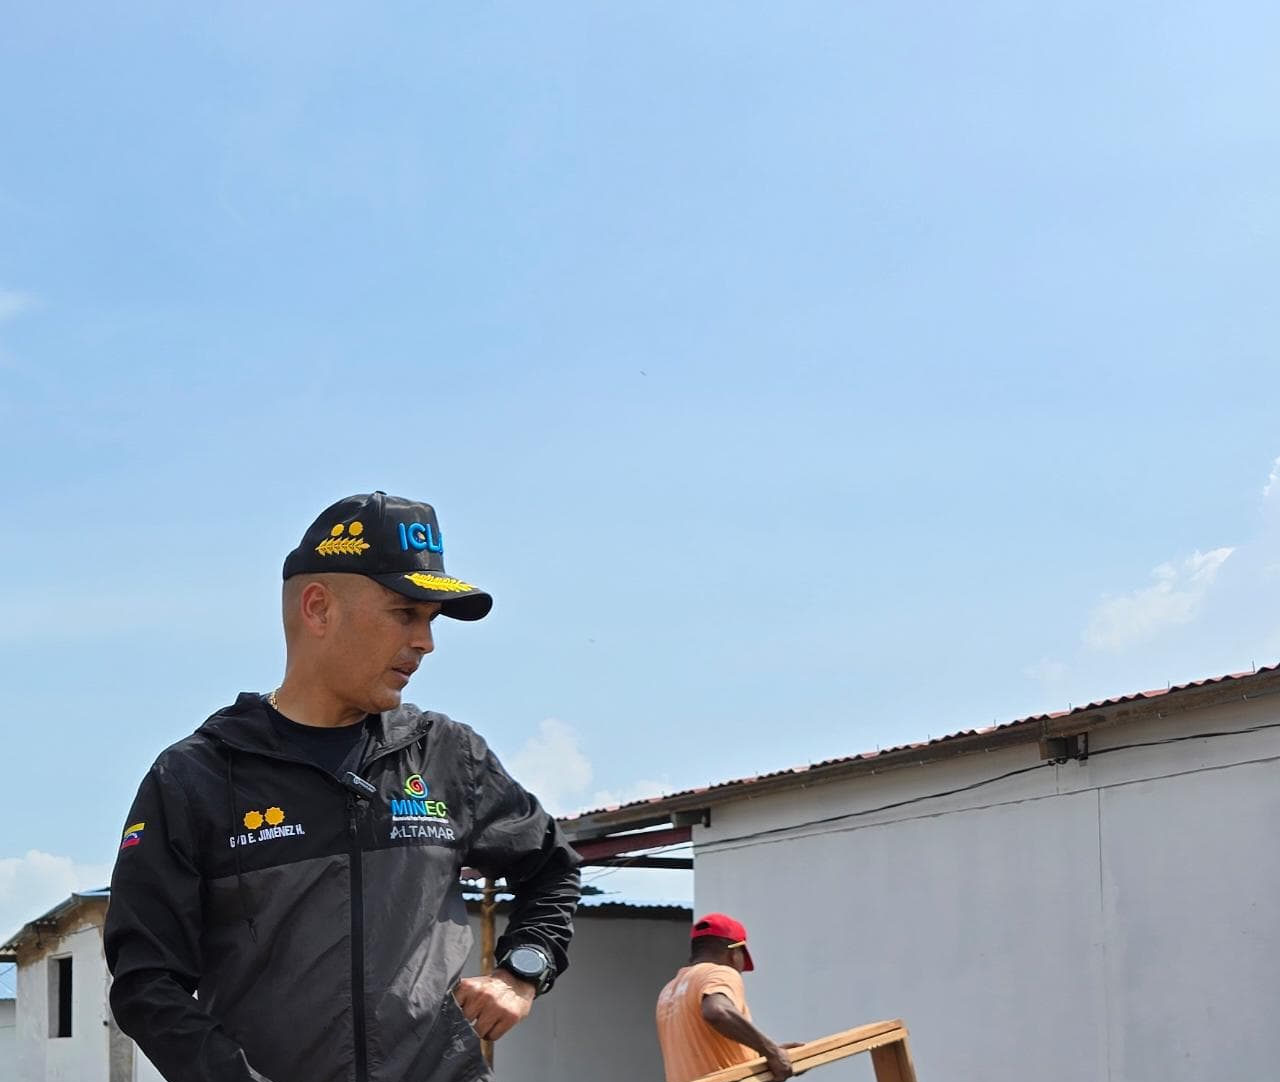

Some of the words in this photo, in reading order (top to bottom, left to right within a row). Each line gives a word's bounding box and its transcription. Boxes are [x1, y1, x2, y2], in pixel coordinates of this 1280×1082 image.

[399, 522, 443, 554] ICL
[391, 799, 447, 817] MINEC
[390, 825, 455, 840] ALTAMAR
